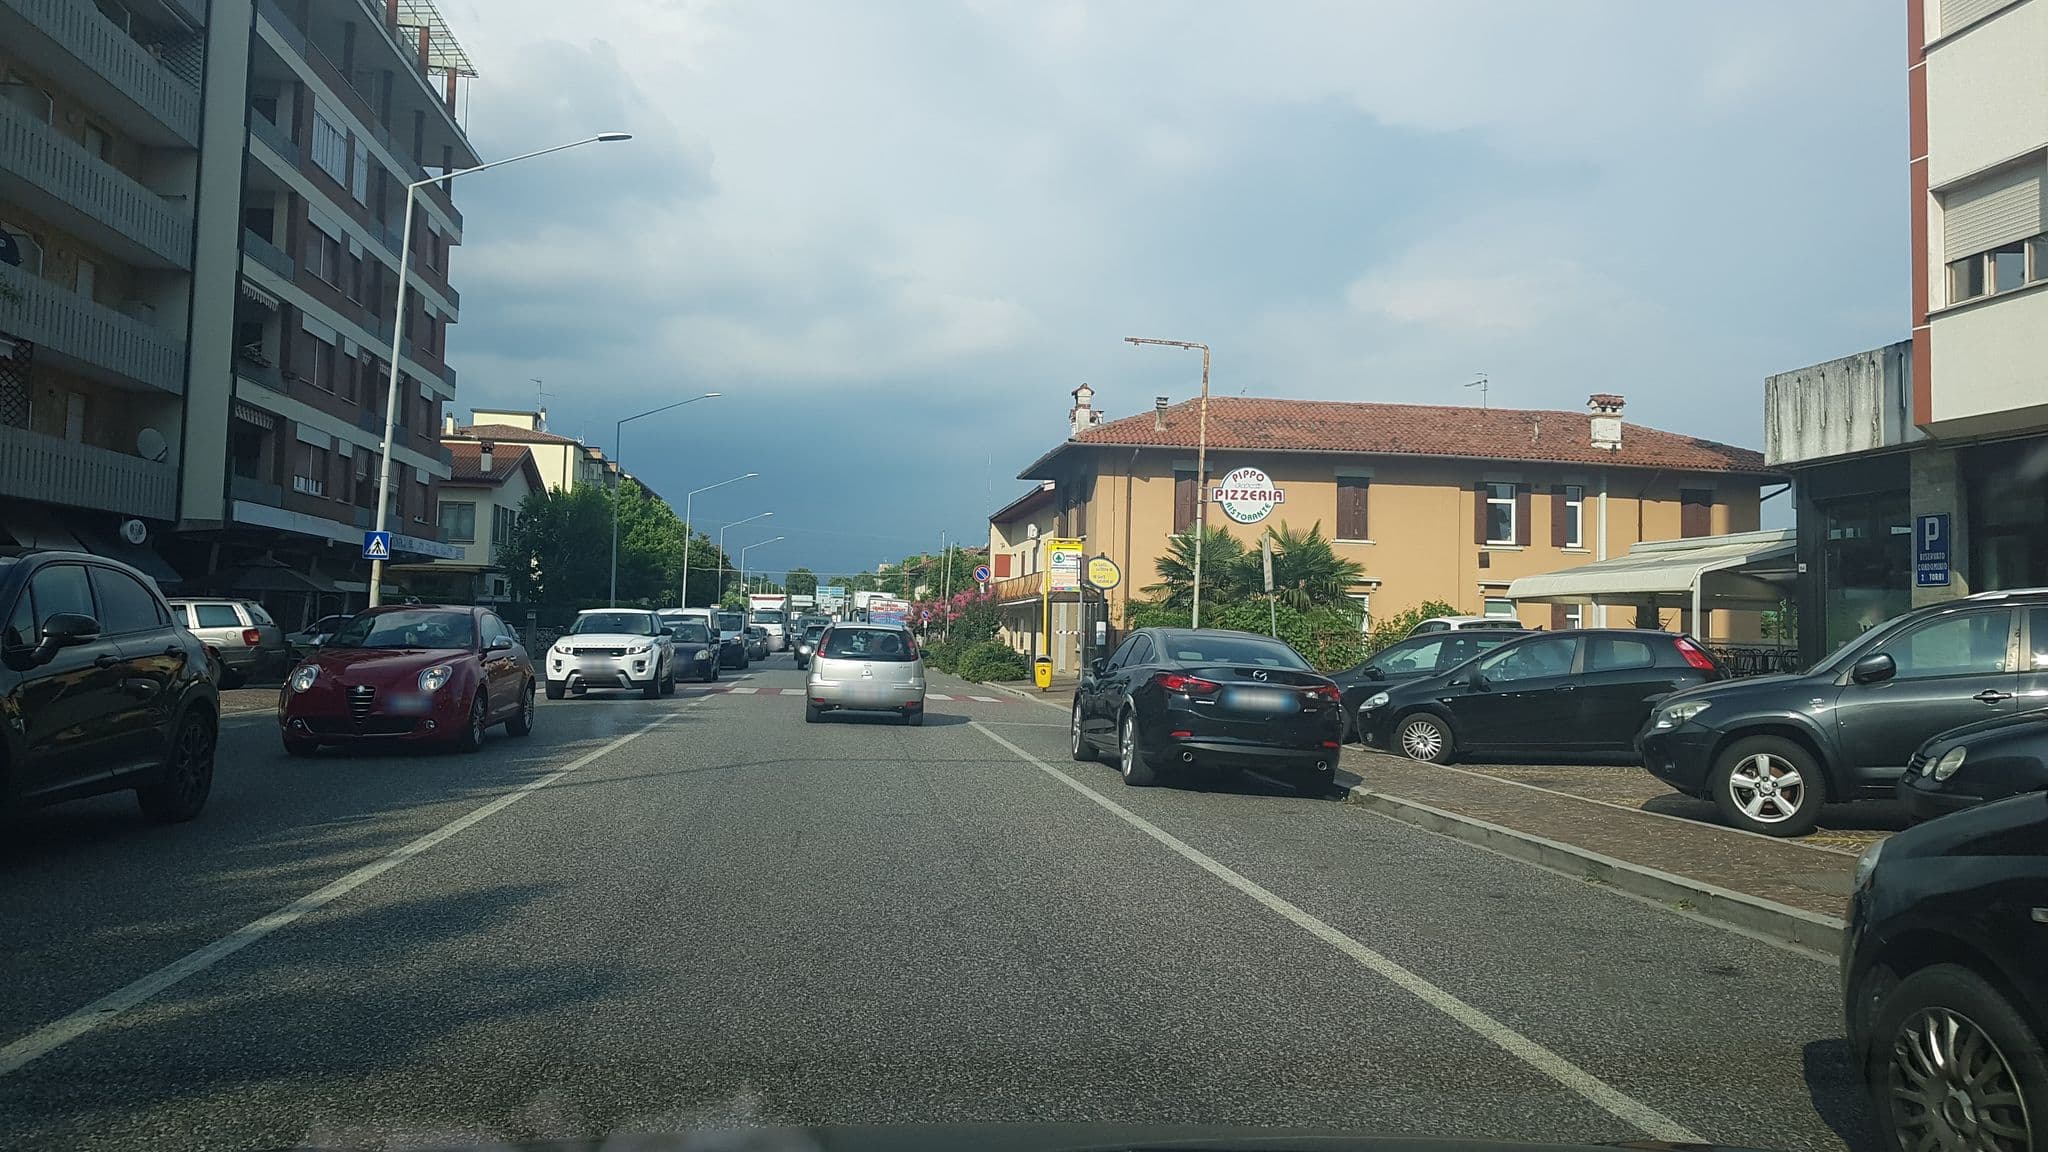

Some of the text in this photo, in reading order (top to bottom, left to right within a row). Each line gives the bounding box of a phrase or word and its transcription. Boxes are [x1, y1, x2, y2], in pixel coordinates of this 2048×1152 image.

[1232, 470, 1264, 482] PIPPO
[1215, 490, 1282, 501] PIZZERIA
[1225, 502, 1271, 520] RISTORANTE
[1925, 517, 1939, 550] P
[1918, 563, 1947, 571] CONDOMINIO
